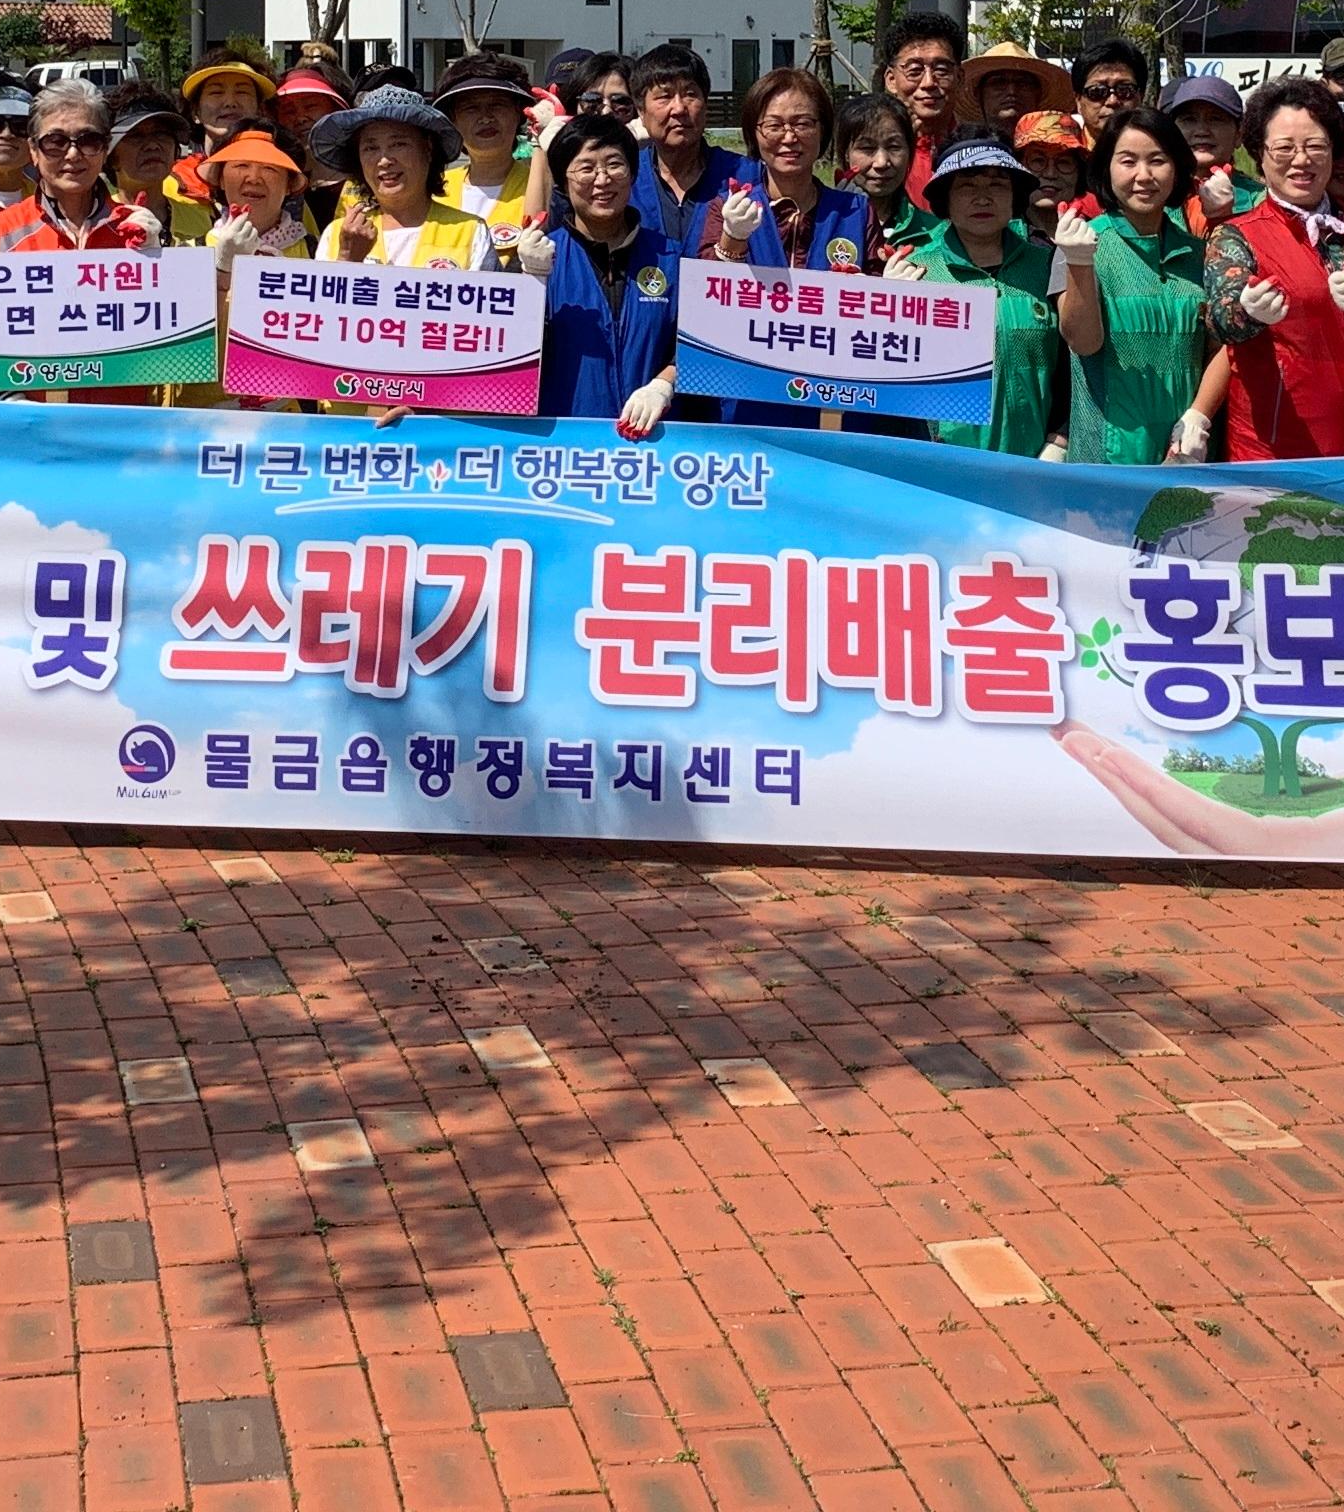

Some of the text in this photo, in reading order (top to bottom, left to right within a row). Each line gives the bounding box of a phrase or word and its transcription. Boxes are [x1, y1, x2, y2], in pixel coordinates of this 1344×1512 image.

[76, 261, 160, 292] 자원!
[258, 271, 516, 317] 분리배출 실천하면
[57, 300, 179, 333] 쓰레기!
[704, 275, 971, 330] 재활용품 분리배출!
[261, 310, 506, 354] 연간 10억 절감!!
[747, 318, 922, 364] 나부터 실천!
[39, 361, 103, 382] 양산시
[364, 378, 424, 400] 양산시
[816, 384, 876, 407] 양산시
[200, 443, 771, 509] 더 큰 변화 더 행복한 양산
[30, 556, 120, 683] 및
[165, 540, 527, 696] 쓰레기
[582, 548, 1065, 715] 분리배출
[204, 734, 801, 806] 물금읍행정복지센터
